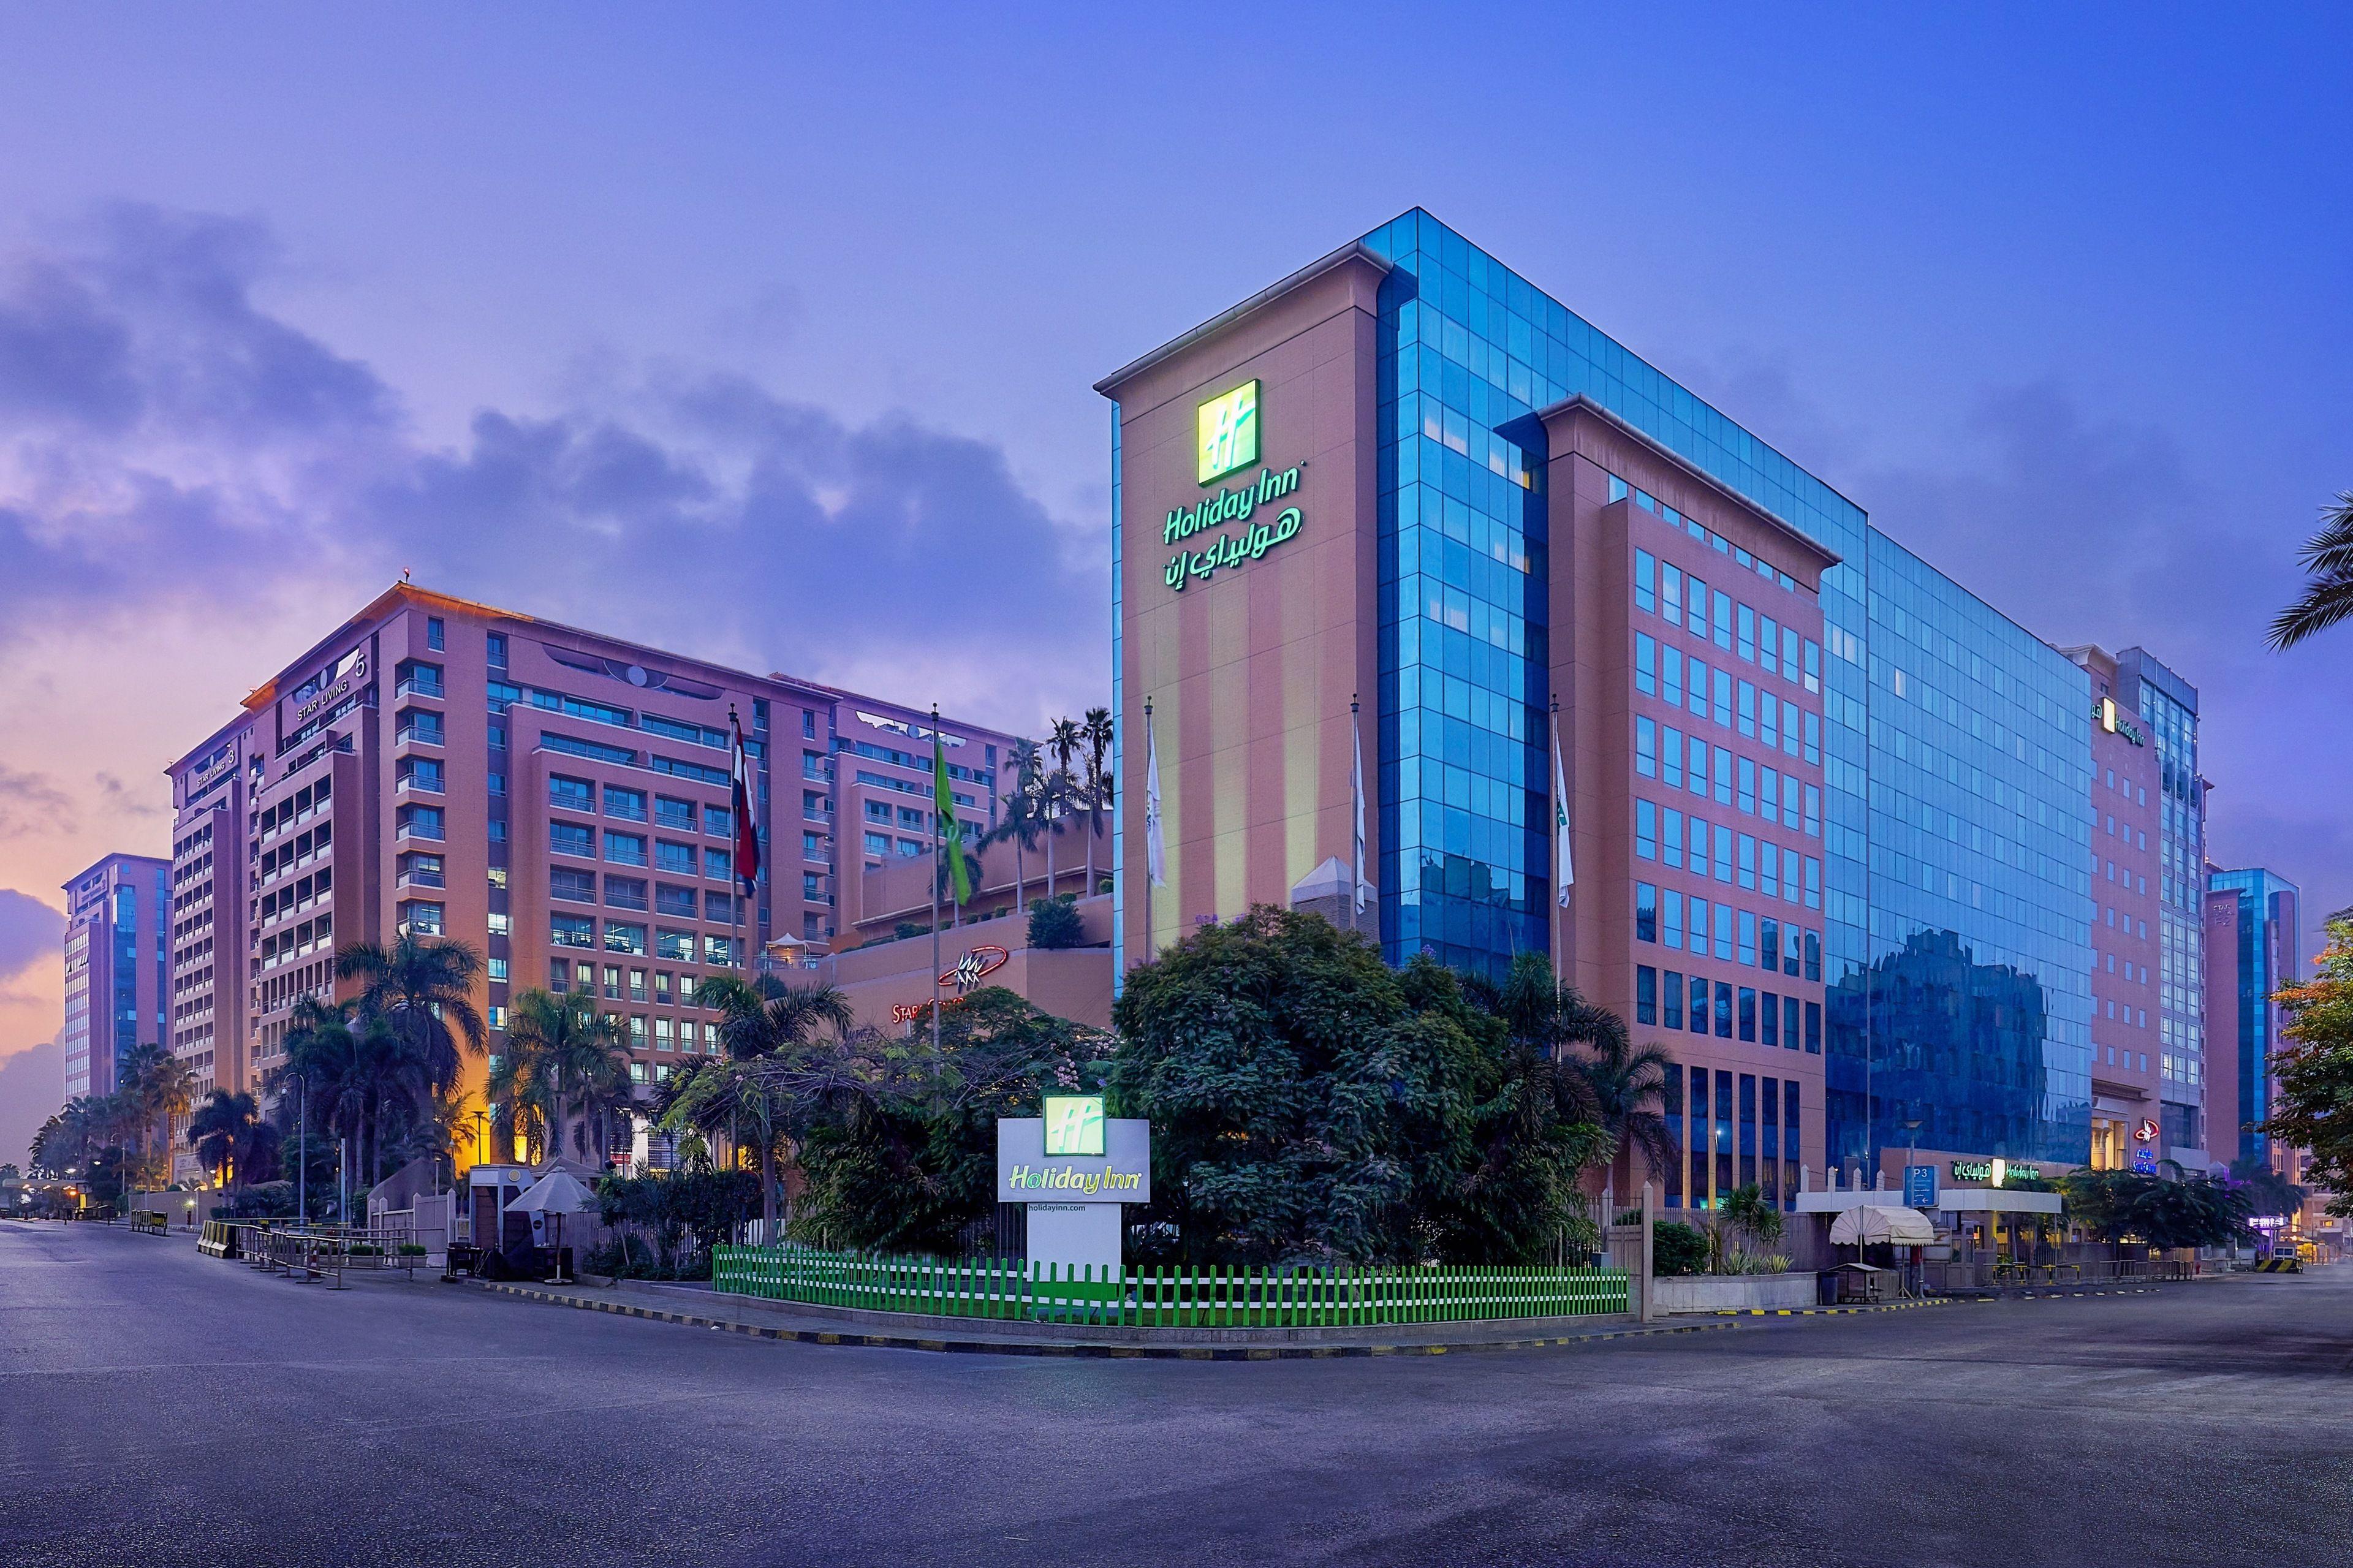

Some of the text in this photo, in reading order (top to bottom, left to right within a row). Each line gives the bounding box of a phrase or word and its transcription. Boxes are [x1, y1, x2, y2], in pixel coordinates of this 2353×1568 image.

[1163, 466, 1302, 545] Holiday Inn
[1164, 507, 1303, 591] هوليداي إن
[355, 653, 365, 677] 5
[297, 680, 348, 721] STAR LIVING
[2115, 714, 2145, 746] Holiday Inn
[228, 749, 235, 764] 3
[197, 762, 225, 787] STAR LIVING
[892, 1004, 922, 1024] STAR
[1009, 1165, 1140, 1195] Holiday Inn
[2006, 1164, 2029, 1180] Holiday
[1028, 1204, 1086, 1213] holidayinn.com
